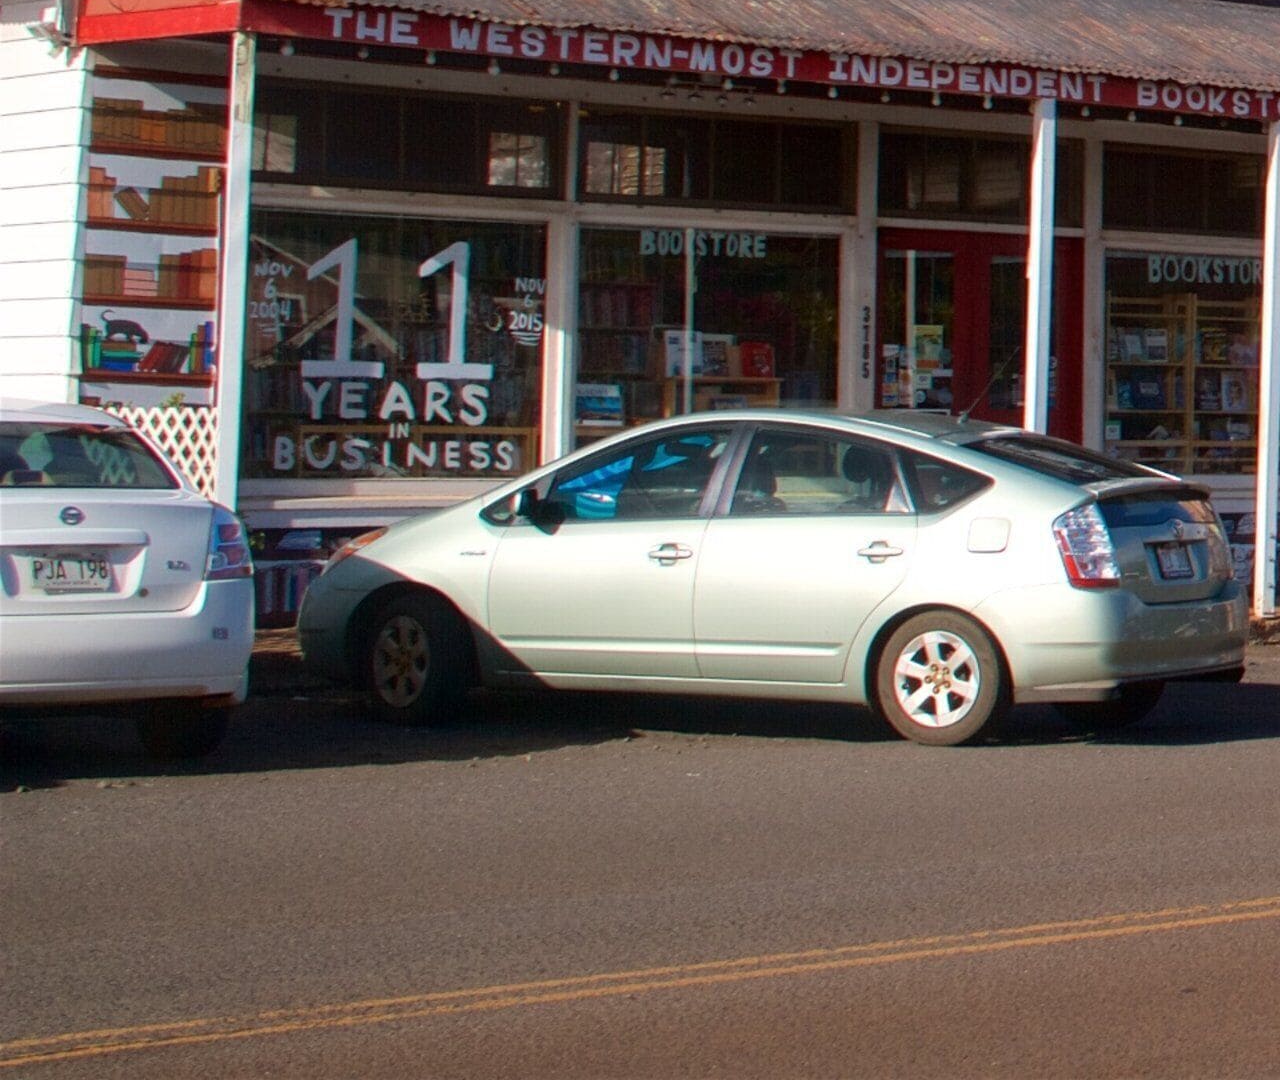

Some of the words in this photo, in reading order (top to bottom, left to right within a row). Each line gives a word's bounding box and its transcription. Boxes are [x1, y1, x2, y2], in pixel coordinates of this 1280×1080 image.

[324, 8, 419, 45] THE
[450, 21, 804, 78] WESTERN-MOST
[828, 53, 1107, 102] INDEPENDENT
[253, 260, 293, 278] NOV
[1148, 254, 1264, 284] BOOKSTOR
[264, 279, 277, 298] 6
[515, 277, 546, 294] NOV
[250, 300, 293, 320] 2004
[300, 237, 494, 380] 11
[524, 294, 533, 308] 6
[508, 310, 544, 332] 2015
[301, 380, 490, 427] YEARS
[388, 422, 410, 439] IN
[272, 435, 516, 472] BUSINESS
[32, 559, 67, 580] PJA
